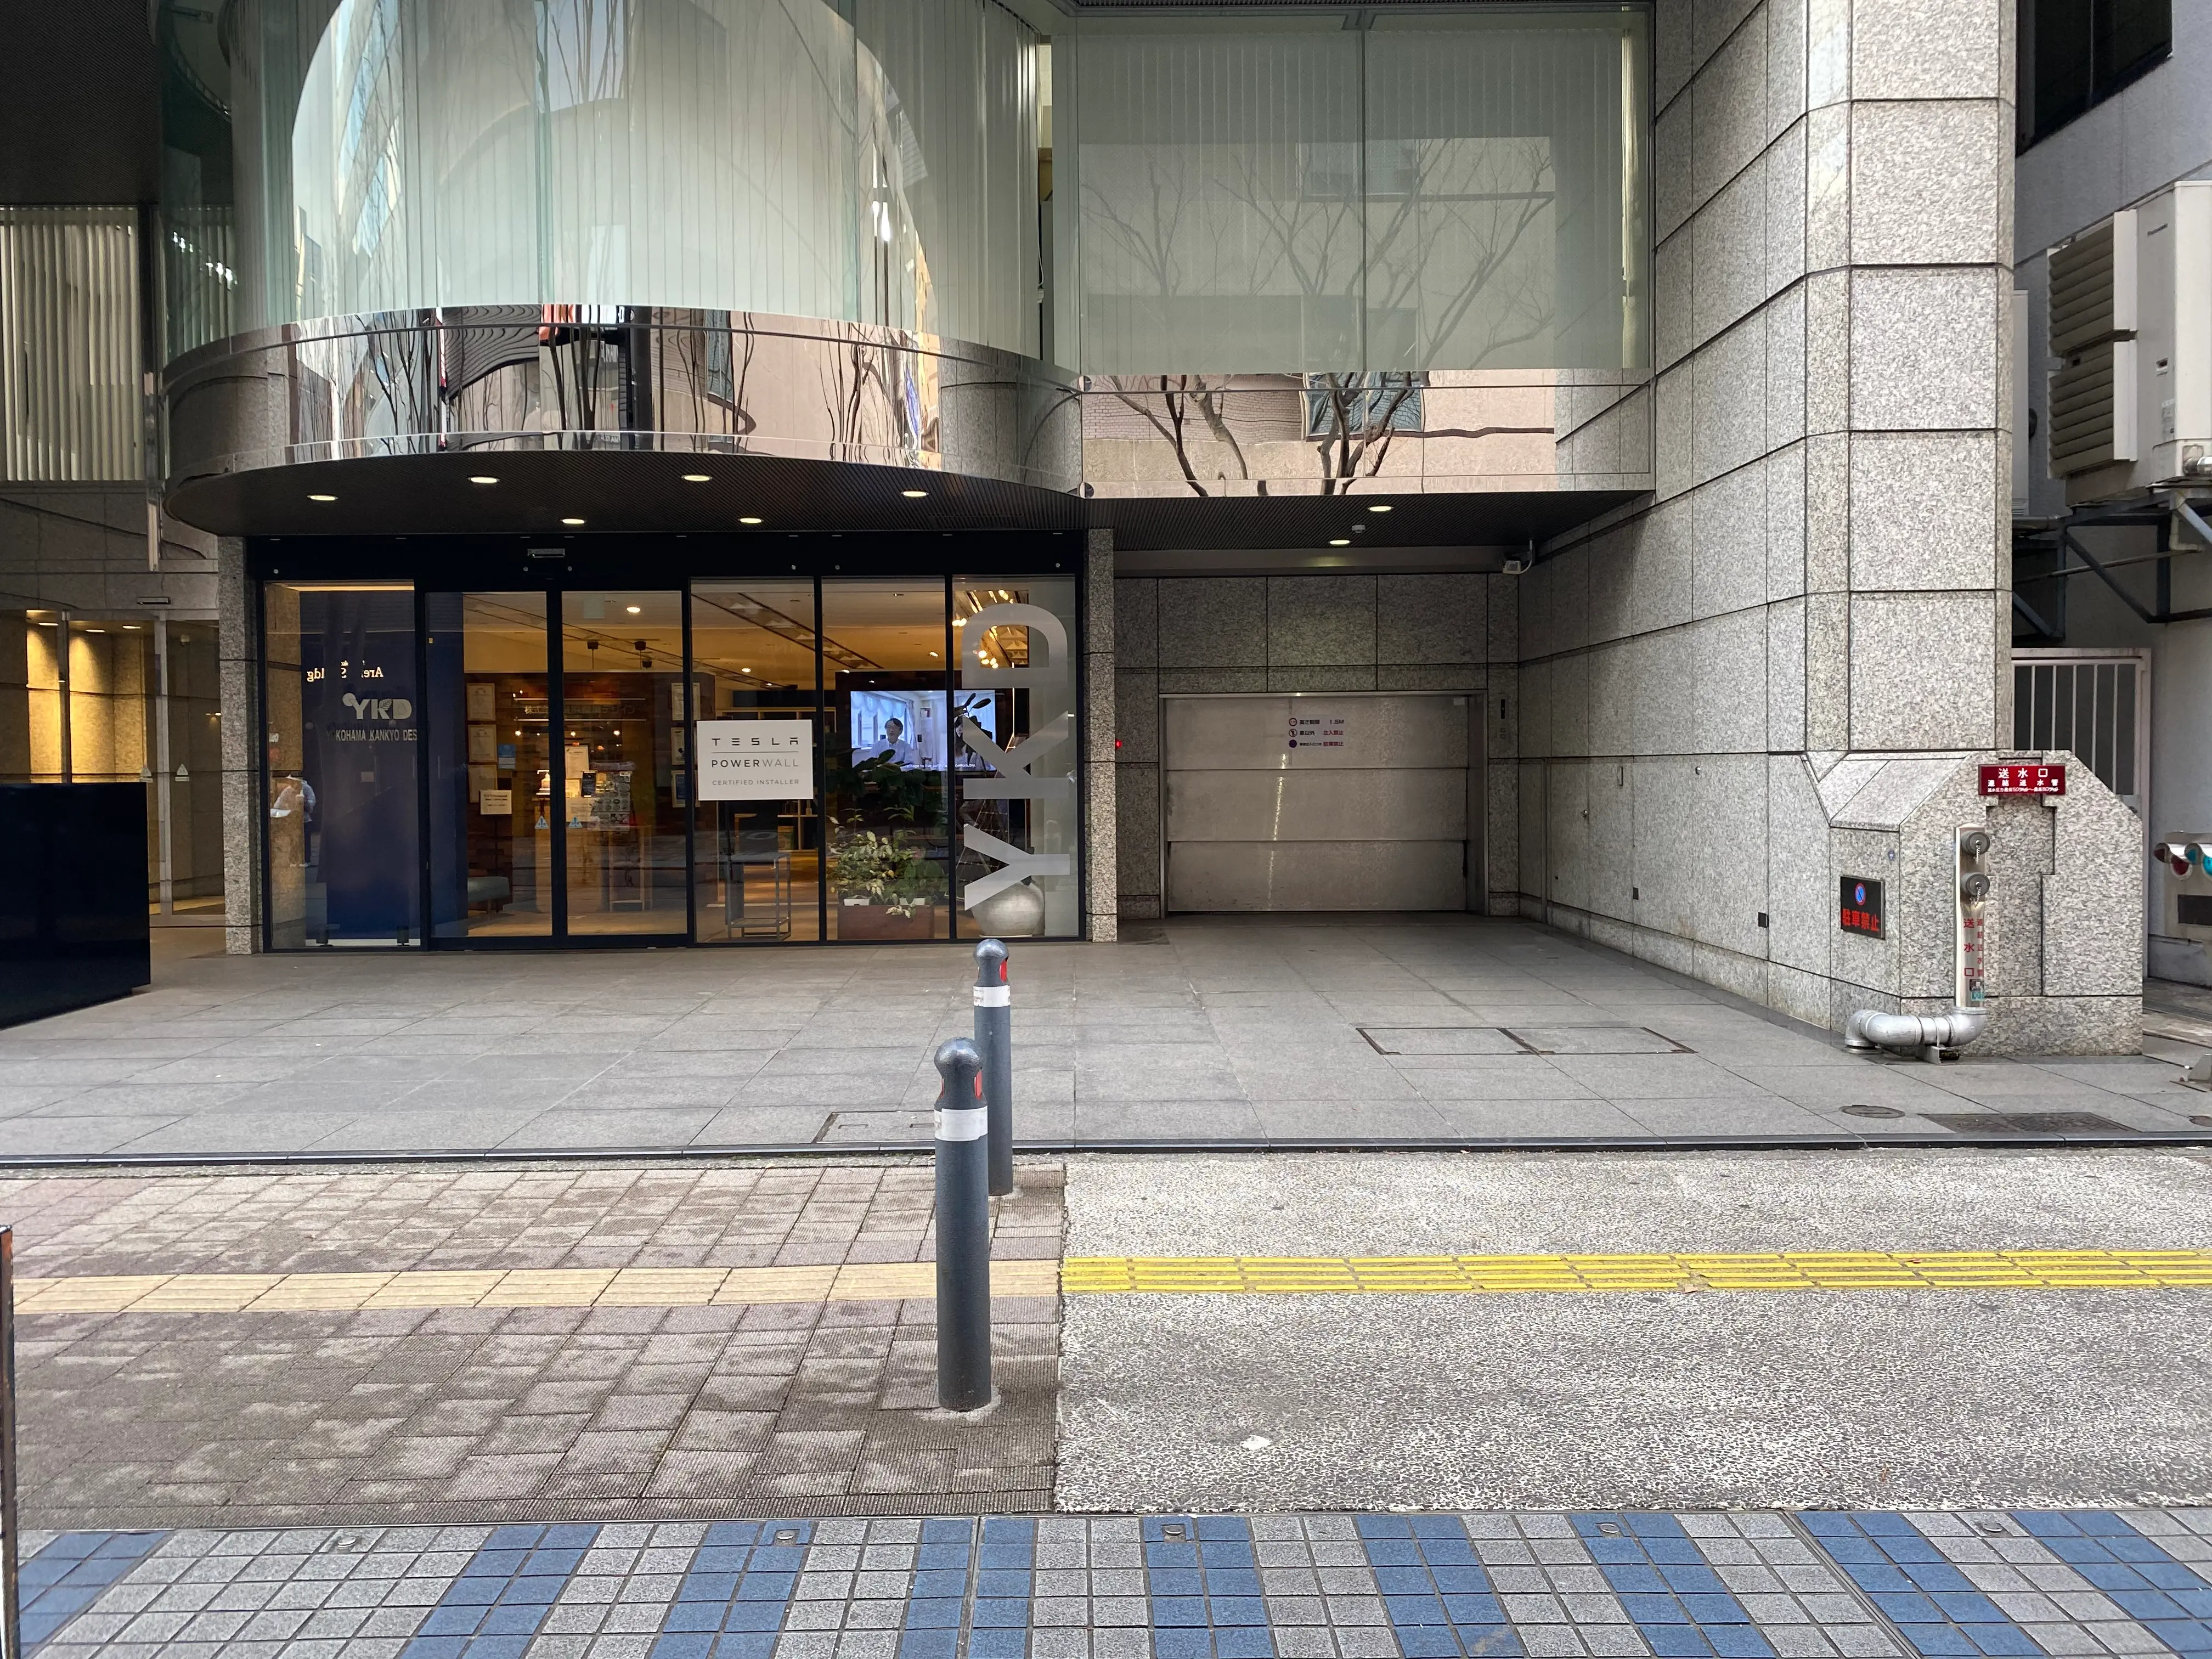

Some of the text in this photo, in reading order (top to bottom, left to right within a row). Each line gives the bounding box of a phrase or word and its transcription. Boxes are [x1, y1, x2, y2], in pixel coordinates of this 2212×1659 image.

[342, 693, 412, 720] YKD
[369, 729, 399, 741] KANKYO
[712, 737, 798, 746] TESLA
[712, 759, 799, 768] POWERWALL
[961, 603, 1070, 911] YKD
[1998, 768, 2048, 778] 送水口
[1842, 909, 1880, 932] 駐車禁止
[1963, 918, 1974, 977] 送水口
